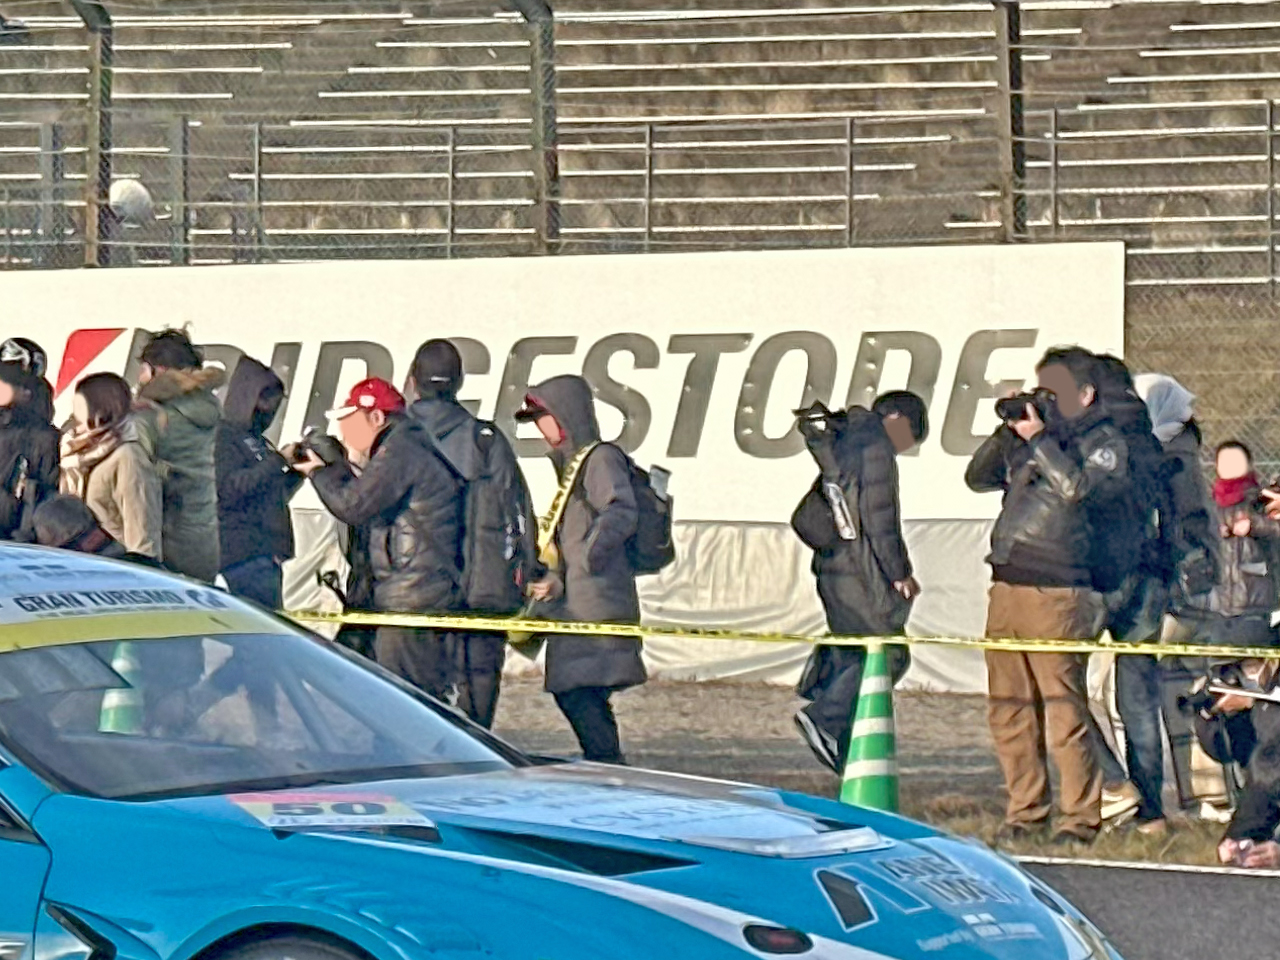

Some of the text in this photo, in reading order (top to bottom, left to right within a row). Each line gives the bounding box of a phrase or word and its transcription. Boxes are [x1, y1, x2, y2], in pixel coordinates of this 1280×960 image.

[12, 591, 83, 613] GRAN
[86, 587, 186, 609] TURISMO
[272, 803, 387, 816] 50
